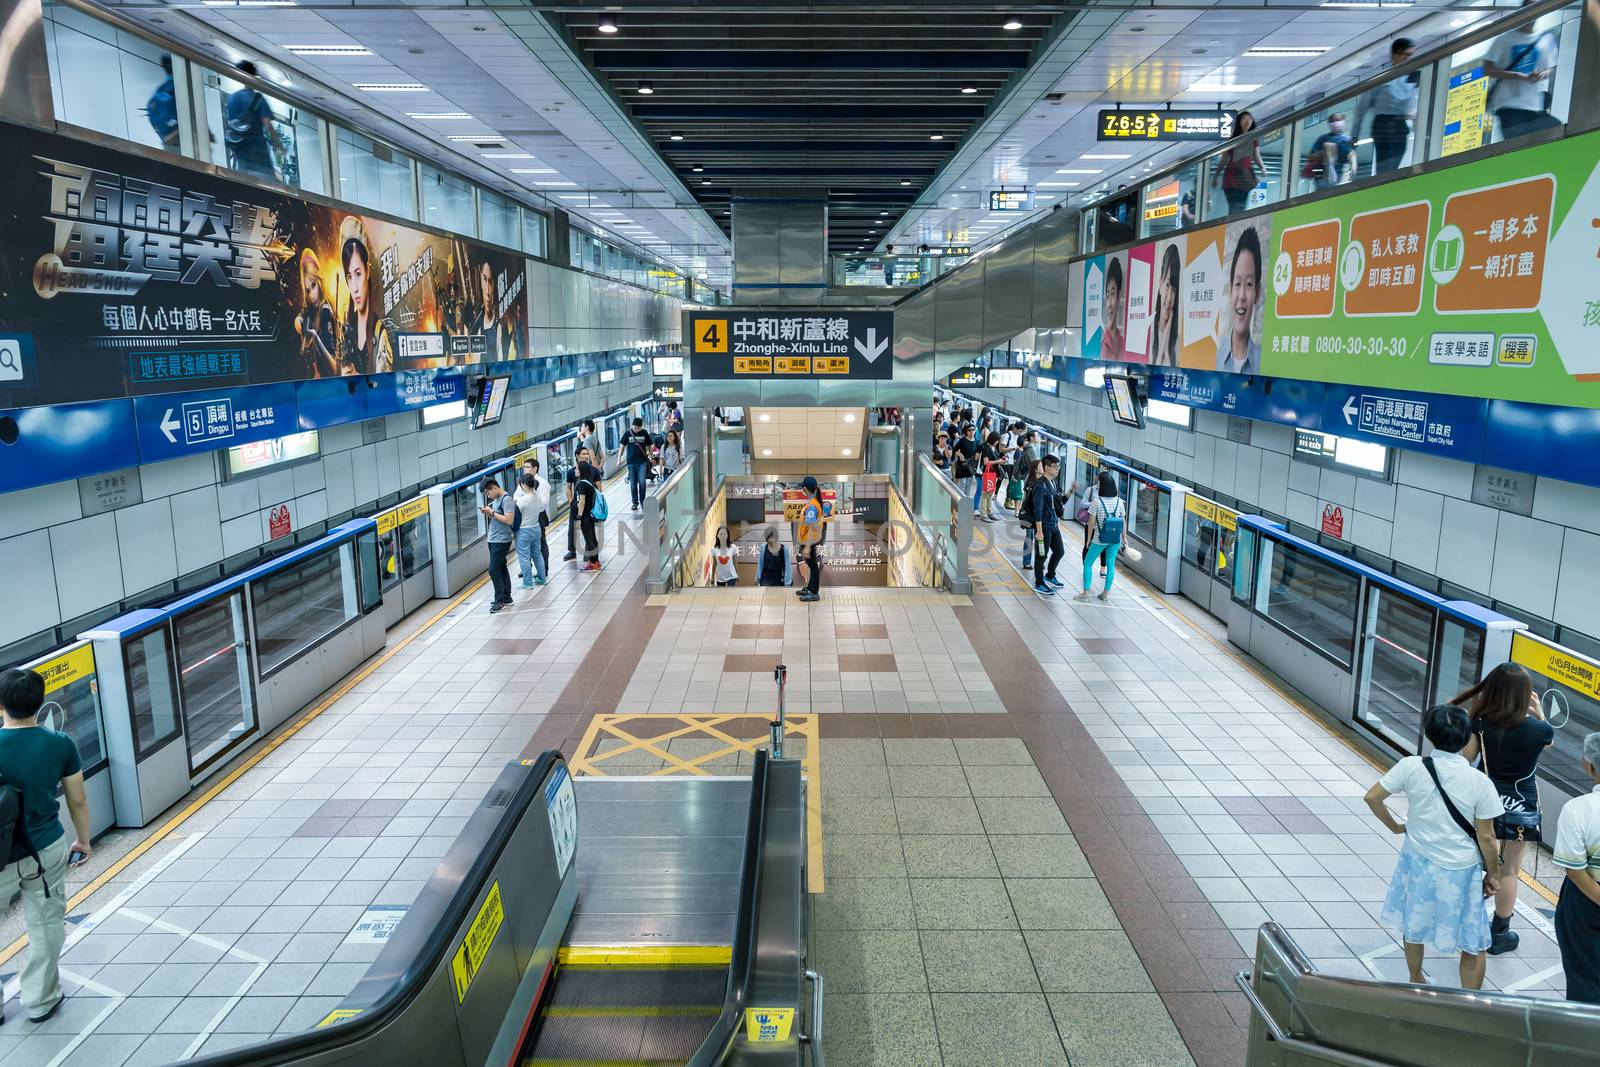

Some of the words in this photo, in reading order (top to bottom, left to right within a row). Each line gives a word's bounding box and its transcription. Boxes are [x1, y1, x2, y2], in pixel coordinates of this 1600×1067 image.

[1474, 214, 1539, 243] 一網多本
[1371, 233, 1419, 258] 私人家教
[1296, 247, 1333, 269] 英語環境
[1470, 251, 1535, 279] 一網打盡
[1294, 274, 1330, 293] 隨時隨地
[1368, 264, 1416, 287] 即時互動
[102, 303, 261, 331] 每個人心中都有一名大兵
[702, 324, 721, 348] 4
[733, 318, 849, 341] 中和新蘆線
[734, 343, 819, 355] Zhonghe-Xinlu
[823, 342, 848, 353] Line
[1272, 336, 1310, 354] 免費試聽
[1315, 336, 1407, 356] 0800-30-30-30
[1434, 341, 1489, 358] 在家學英語
[1504, 341, 1529, 359] 搜尋
[206, 405, 227, 423] 頂埔
[249, 407, 274, 420] 台北車站
[1365, 406, 1372, 422] 5
[1375, 400, 1426, 421] 南港展覽館
[192, 414, 200, 431] 5
[208, 425, 229, 434] Dingpu
[1375, 415, 1391, 425] Taipei
[1391, 418, 1417, 431] Nangang
[1428, 423, 1451, 437] 市政府
[1374, 425, 1400, 436] Exhibition
[1401, 430, 1423, 440] Center
